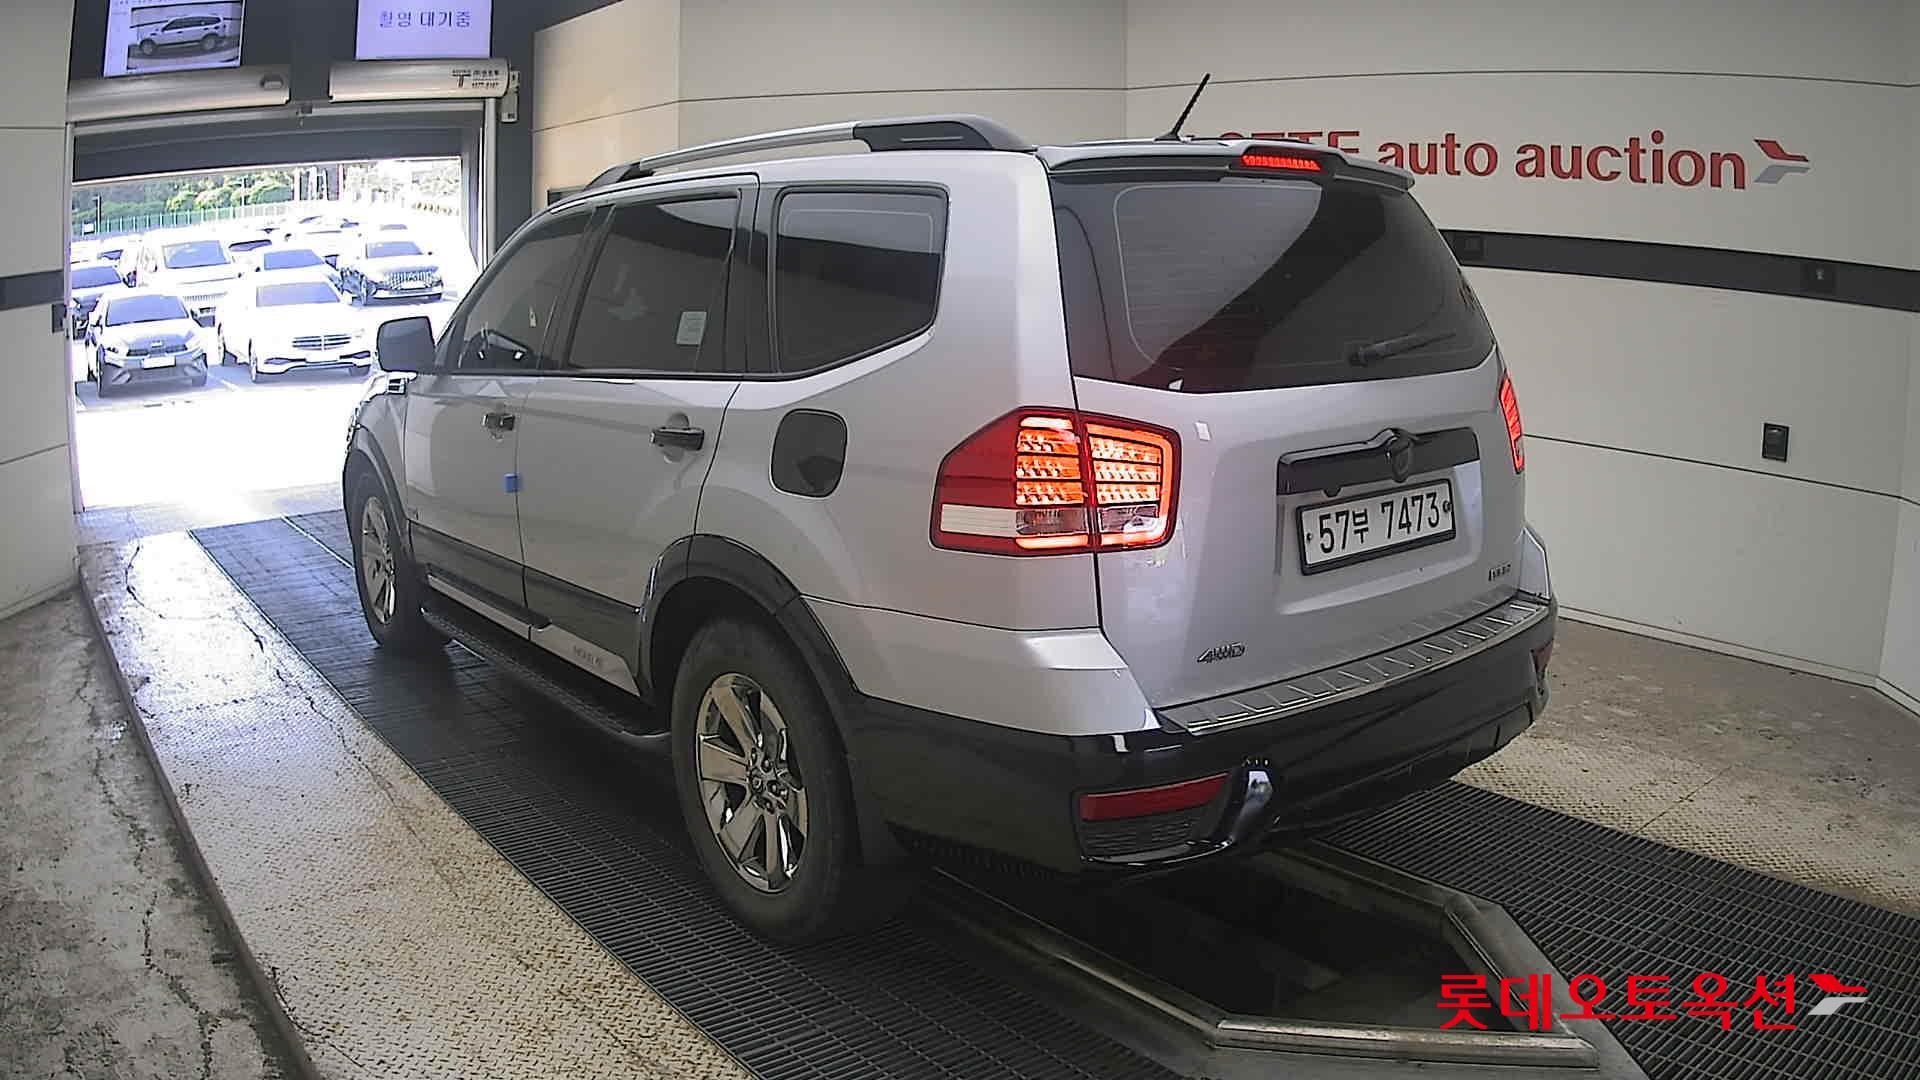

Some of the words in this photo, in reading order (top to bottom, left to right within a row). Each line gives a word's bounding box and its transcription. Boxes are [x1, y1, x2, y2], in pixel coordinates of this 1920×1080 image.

[419, 10, 471, 28] 대기중
[1379, 133, 1498, 176] auto
[1517, 131, 1746, 189] auction
[1318, 508, 1369, 553] 57부
[1380, 491, 1440, 539] 7473
[1197, 641, 1246, 663] 4WD
